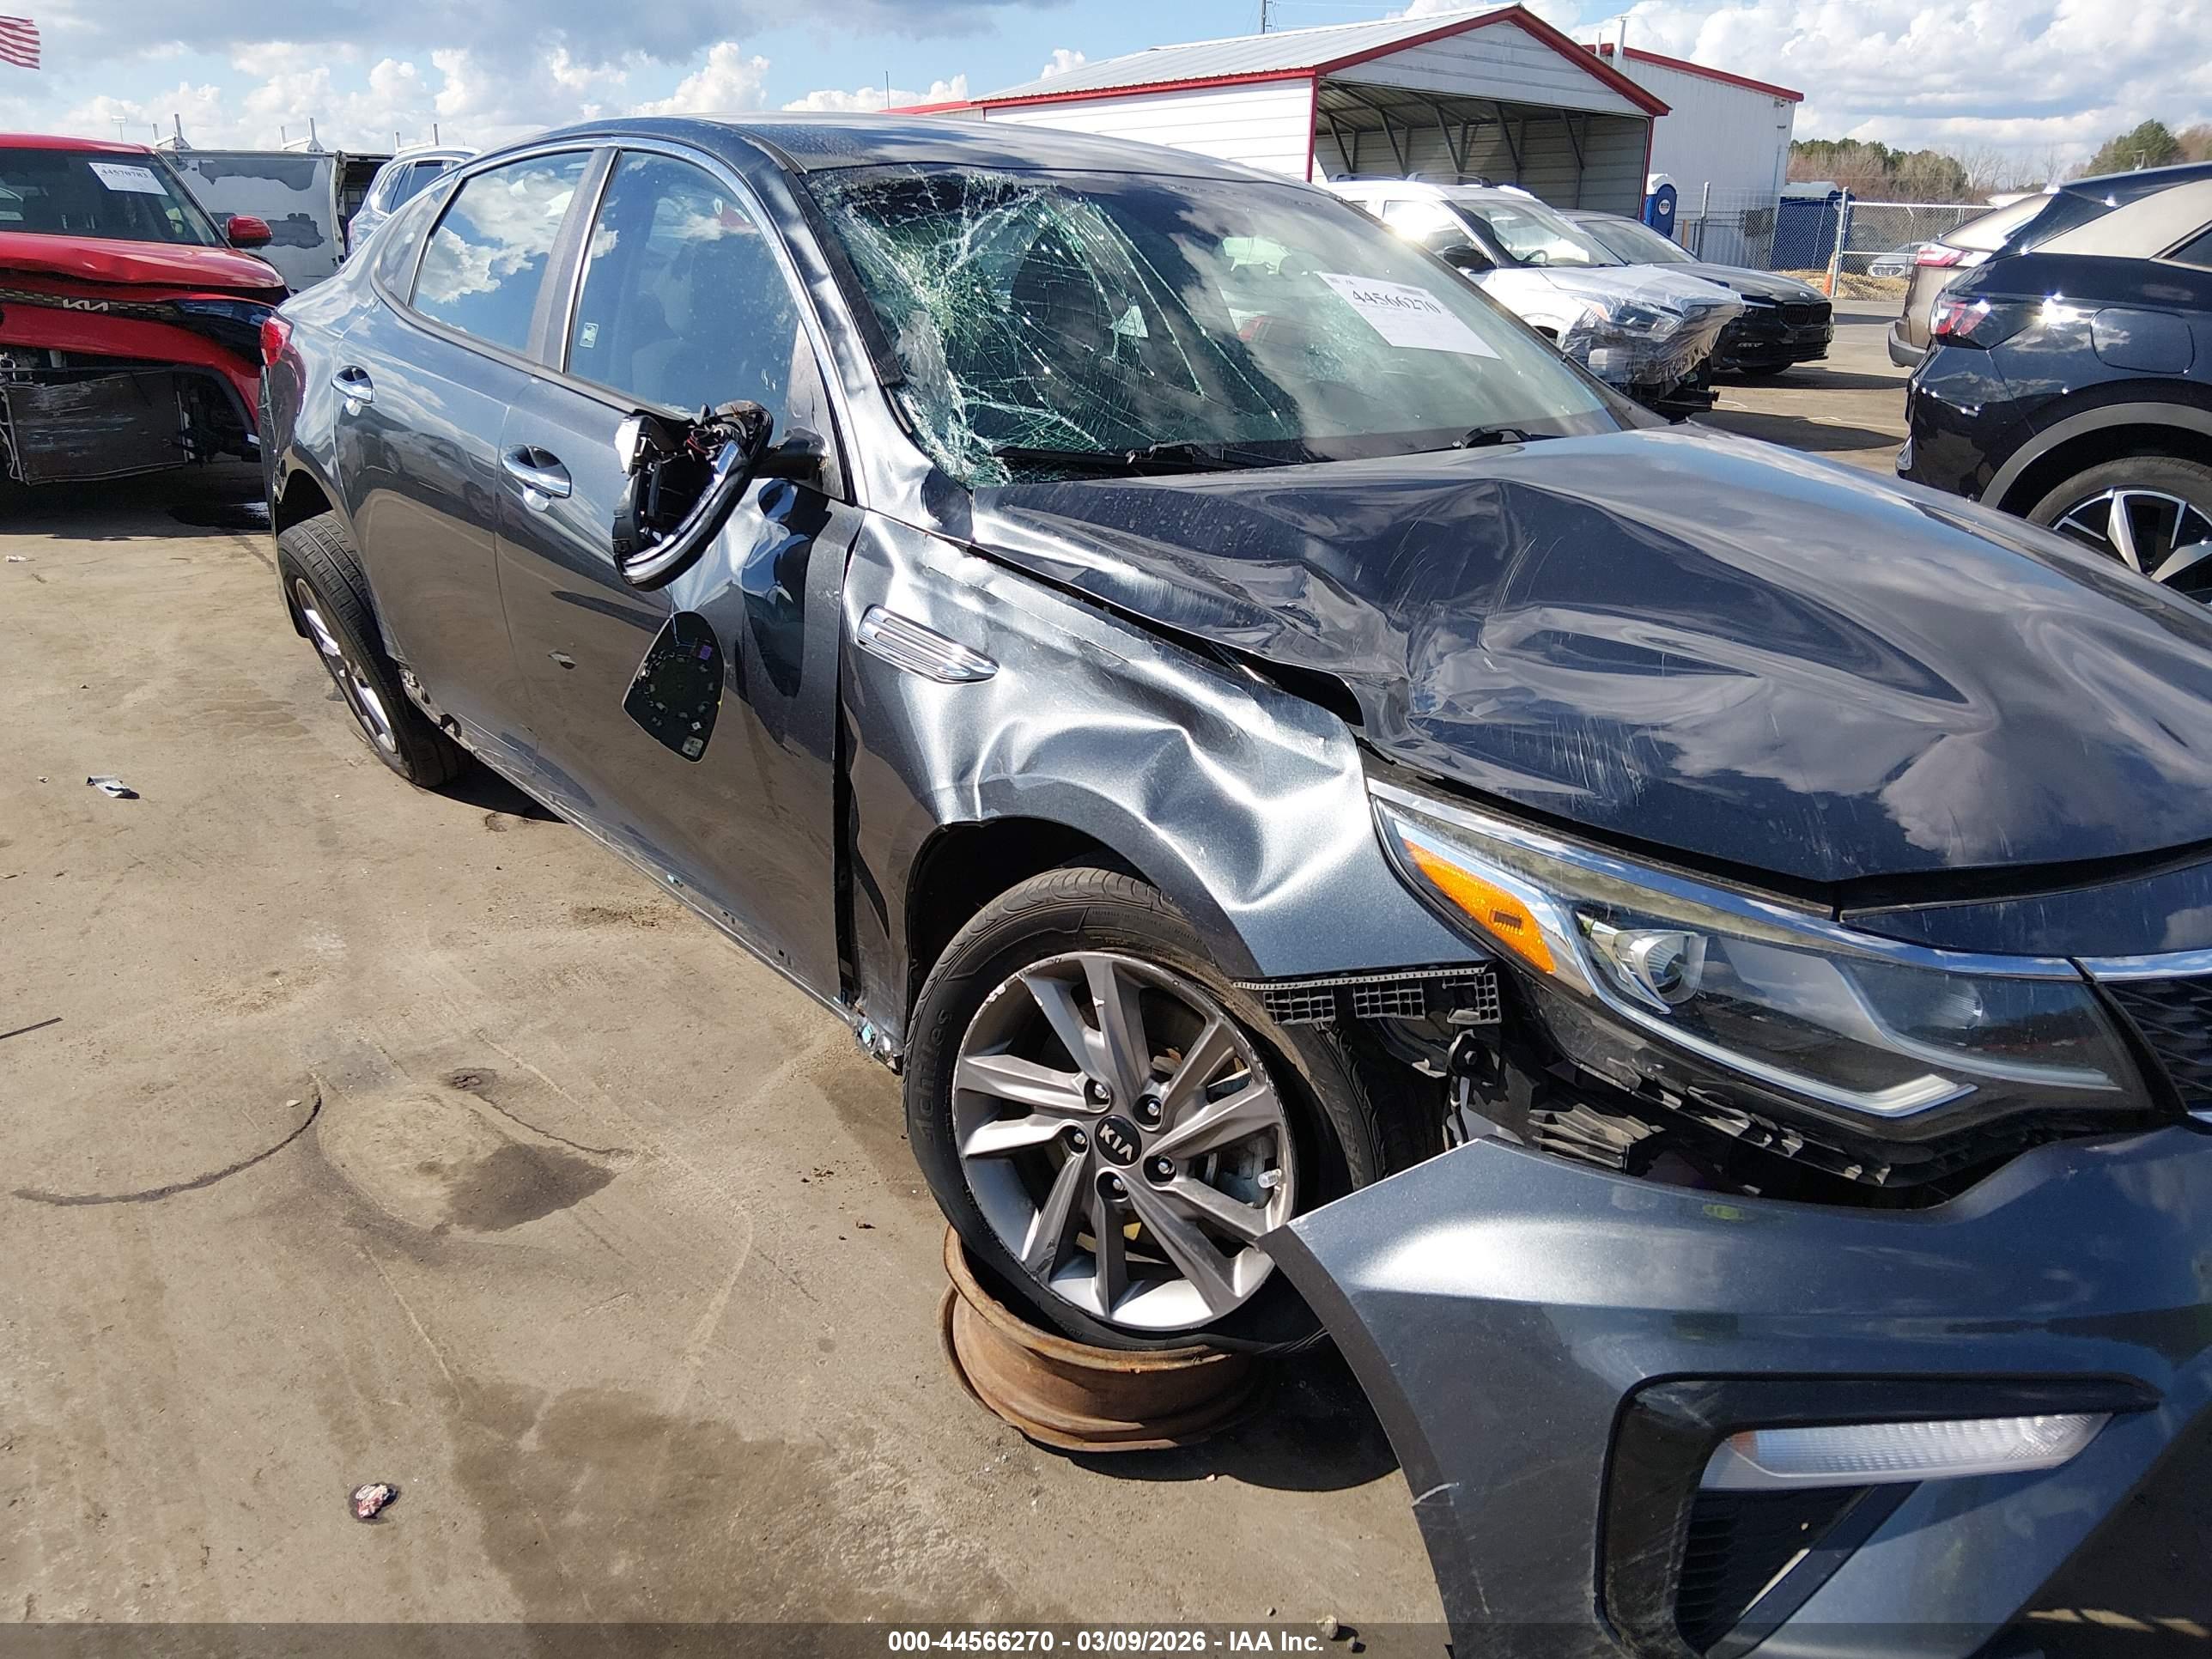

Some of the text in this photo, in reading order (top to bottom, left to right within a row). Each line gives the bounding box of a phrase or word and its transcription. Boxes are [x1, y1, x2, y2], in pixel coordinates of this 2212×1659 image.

[63, 298, 109, 312] KIA
[1352, 289, 1442, 314] 44566270
[1099, 1123, 1133, 1162] KIA
